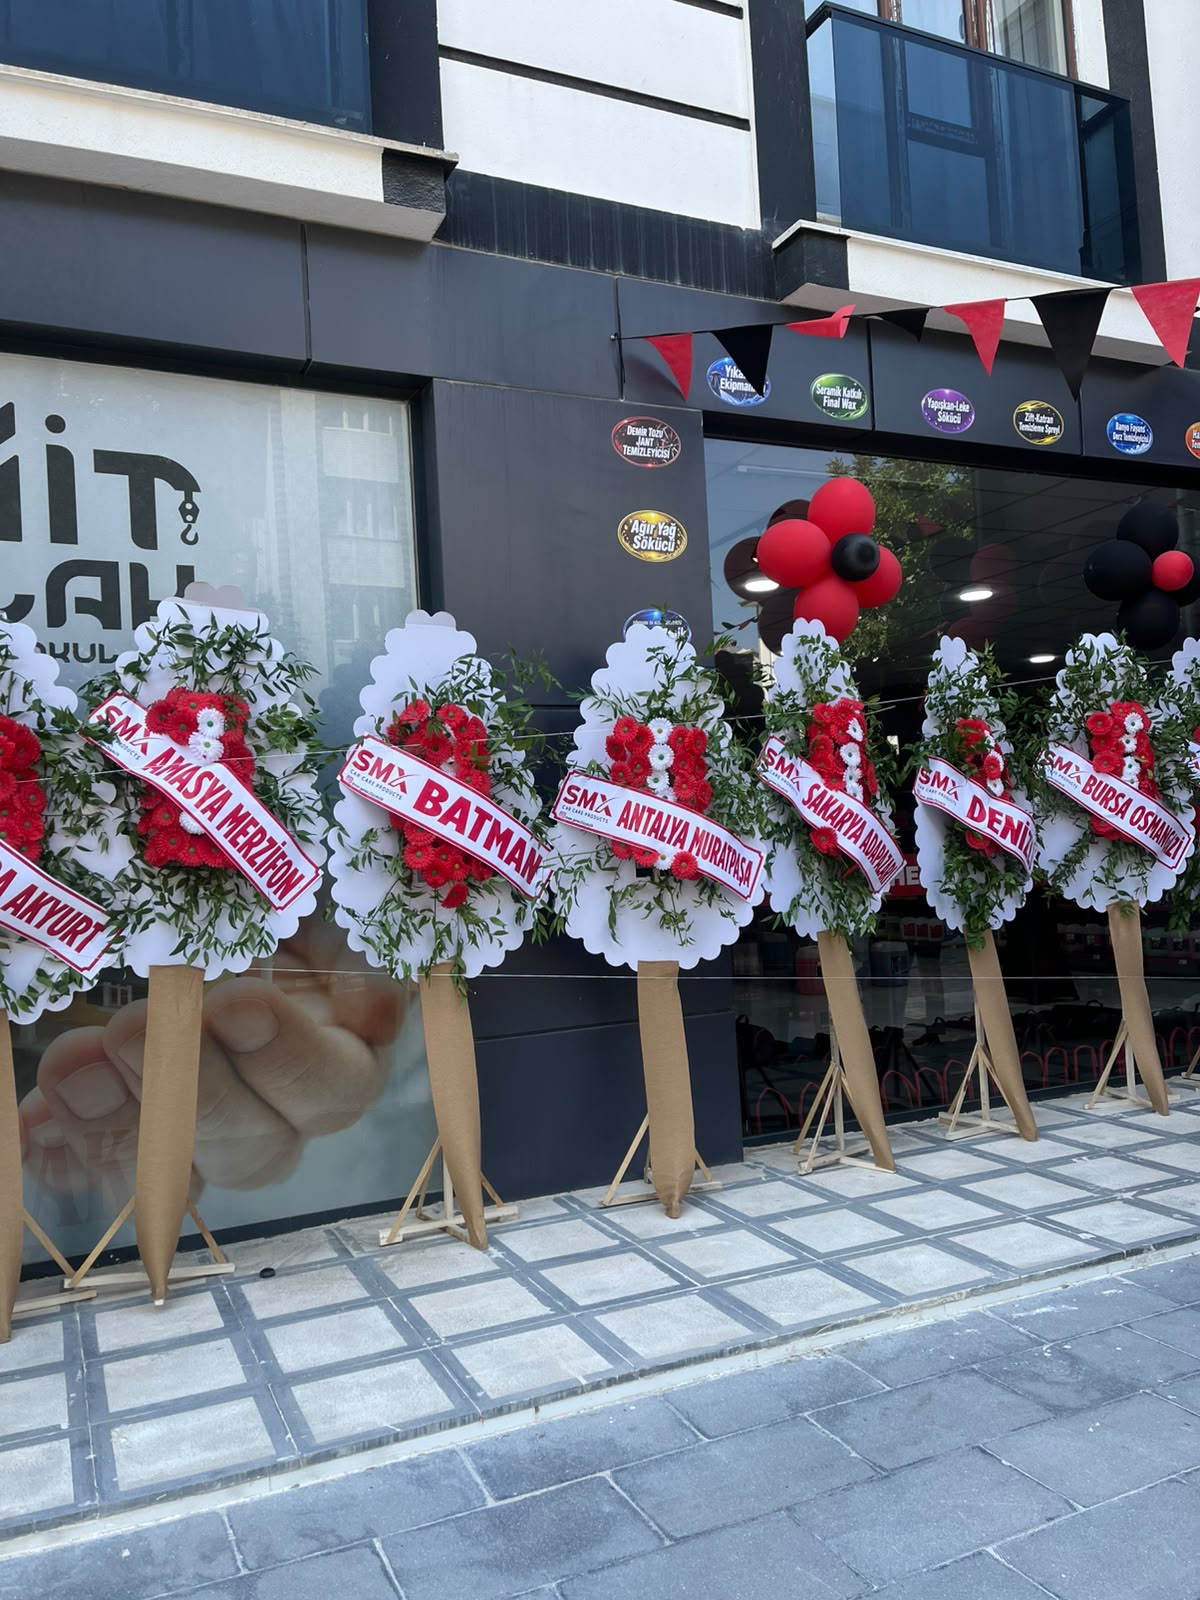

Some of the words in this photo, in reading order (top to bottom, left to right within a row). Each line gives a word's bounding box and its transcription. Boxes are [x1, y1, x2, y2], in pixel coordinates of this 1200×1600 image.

[725, 365, 747, 379] Yıka
[816, 384, 841, 397] Seramik
[823, 396, 840, 408] Final
[841, 398, 857, 410] Wax
[635, 436, 655, 447] JANT
[630, 519, 656, 537] Ağır
[657, 521, 677, 539] Yağ
[632, 534, 676, 552] Sökücü
[375, 783, 403, 800] PRODUCTS
[918, 767, 961, 801] SMX
[1042, 750, 1084, 785] SMX
[1081, 774, 1133, 820] BURSA
[96, 706, 156, 756] SMX
[143, 747, 233, 823] AMASYA
[215, 801, 305, 902] MERZİFON
[764, 748, 803, 792] SMX
[802, 783, 867, 844] SAKARYA
[353, 749, 414, 795] SMX
[412, 778, 543, 885] BATMAN
[584, 812, 609, 824] PRODUCTS
[563, 784, 614, 817] SMX
[616, 800, 690, 851] ANTALYA
[689, 826, 753, 887] MURATPAŞA
[1, 883, 106, 954] AKYURT
